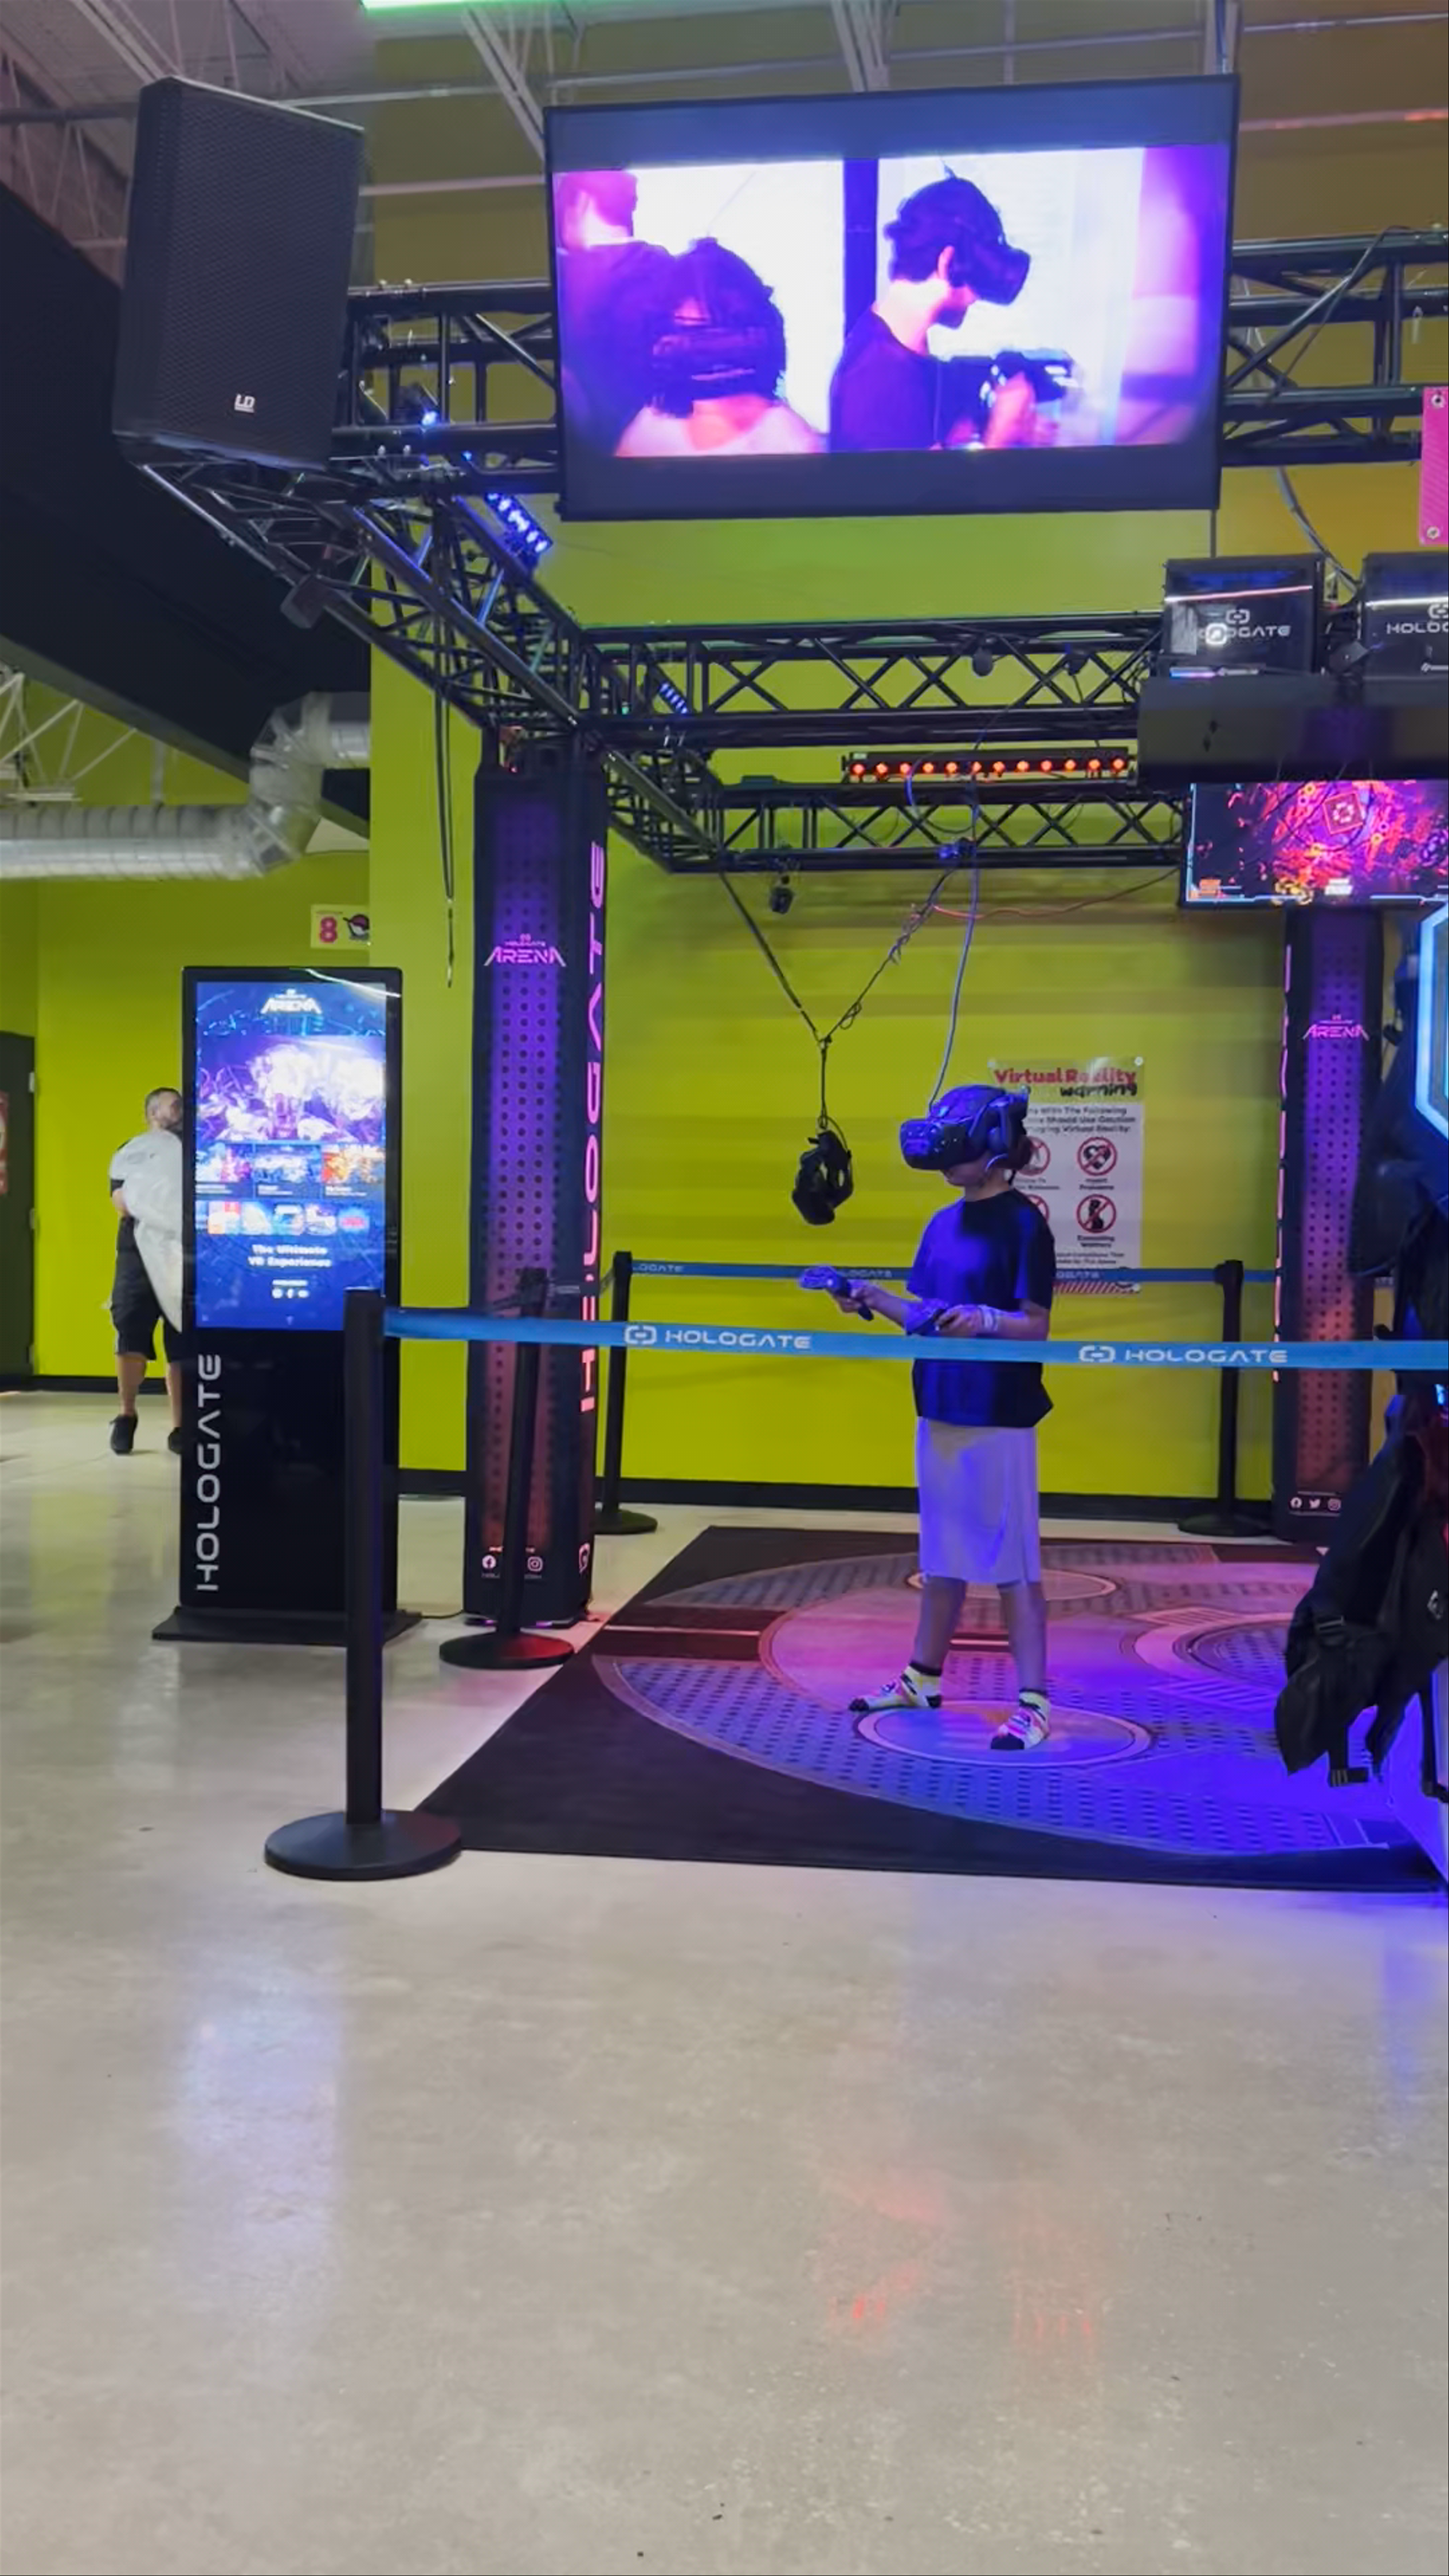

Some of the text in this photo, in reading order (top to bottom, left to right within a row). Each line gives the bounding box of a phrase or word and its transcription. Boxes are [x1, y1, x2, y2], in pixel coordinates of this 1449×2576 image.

[234, 394, 255, 412] LD
[320, 917, 338, 943] 8
[483, 946, 566, 967] ARENA
[1302, 1024, 1370, 1041] ARENA
[994, 1068, 1062, 1083] Virtual
[633, 1263, 684, 1272] OGATE
[665, 1330, 812, 1349] HOLOGATE
[1124, 1349, 1288, 1363] HOLOGATE
[196, 1354, 222, 1591] HOLOGATE
